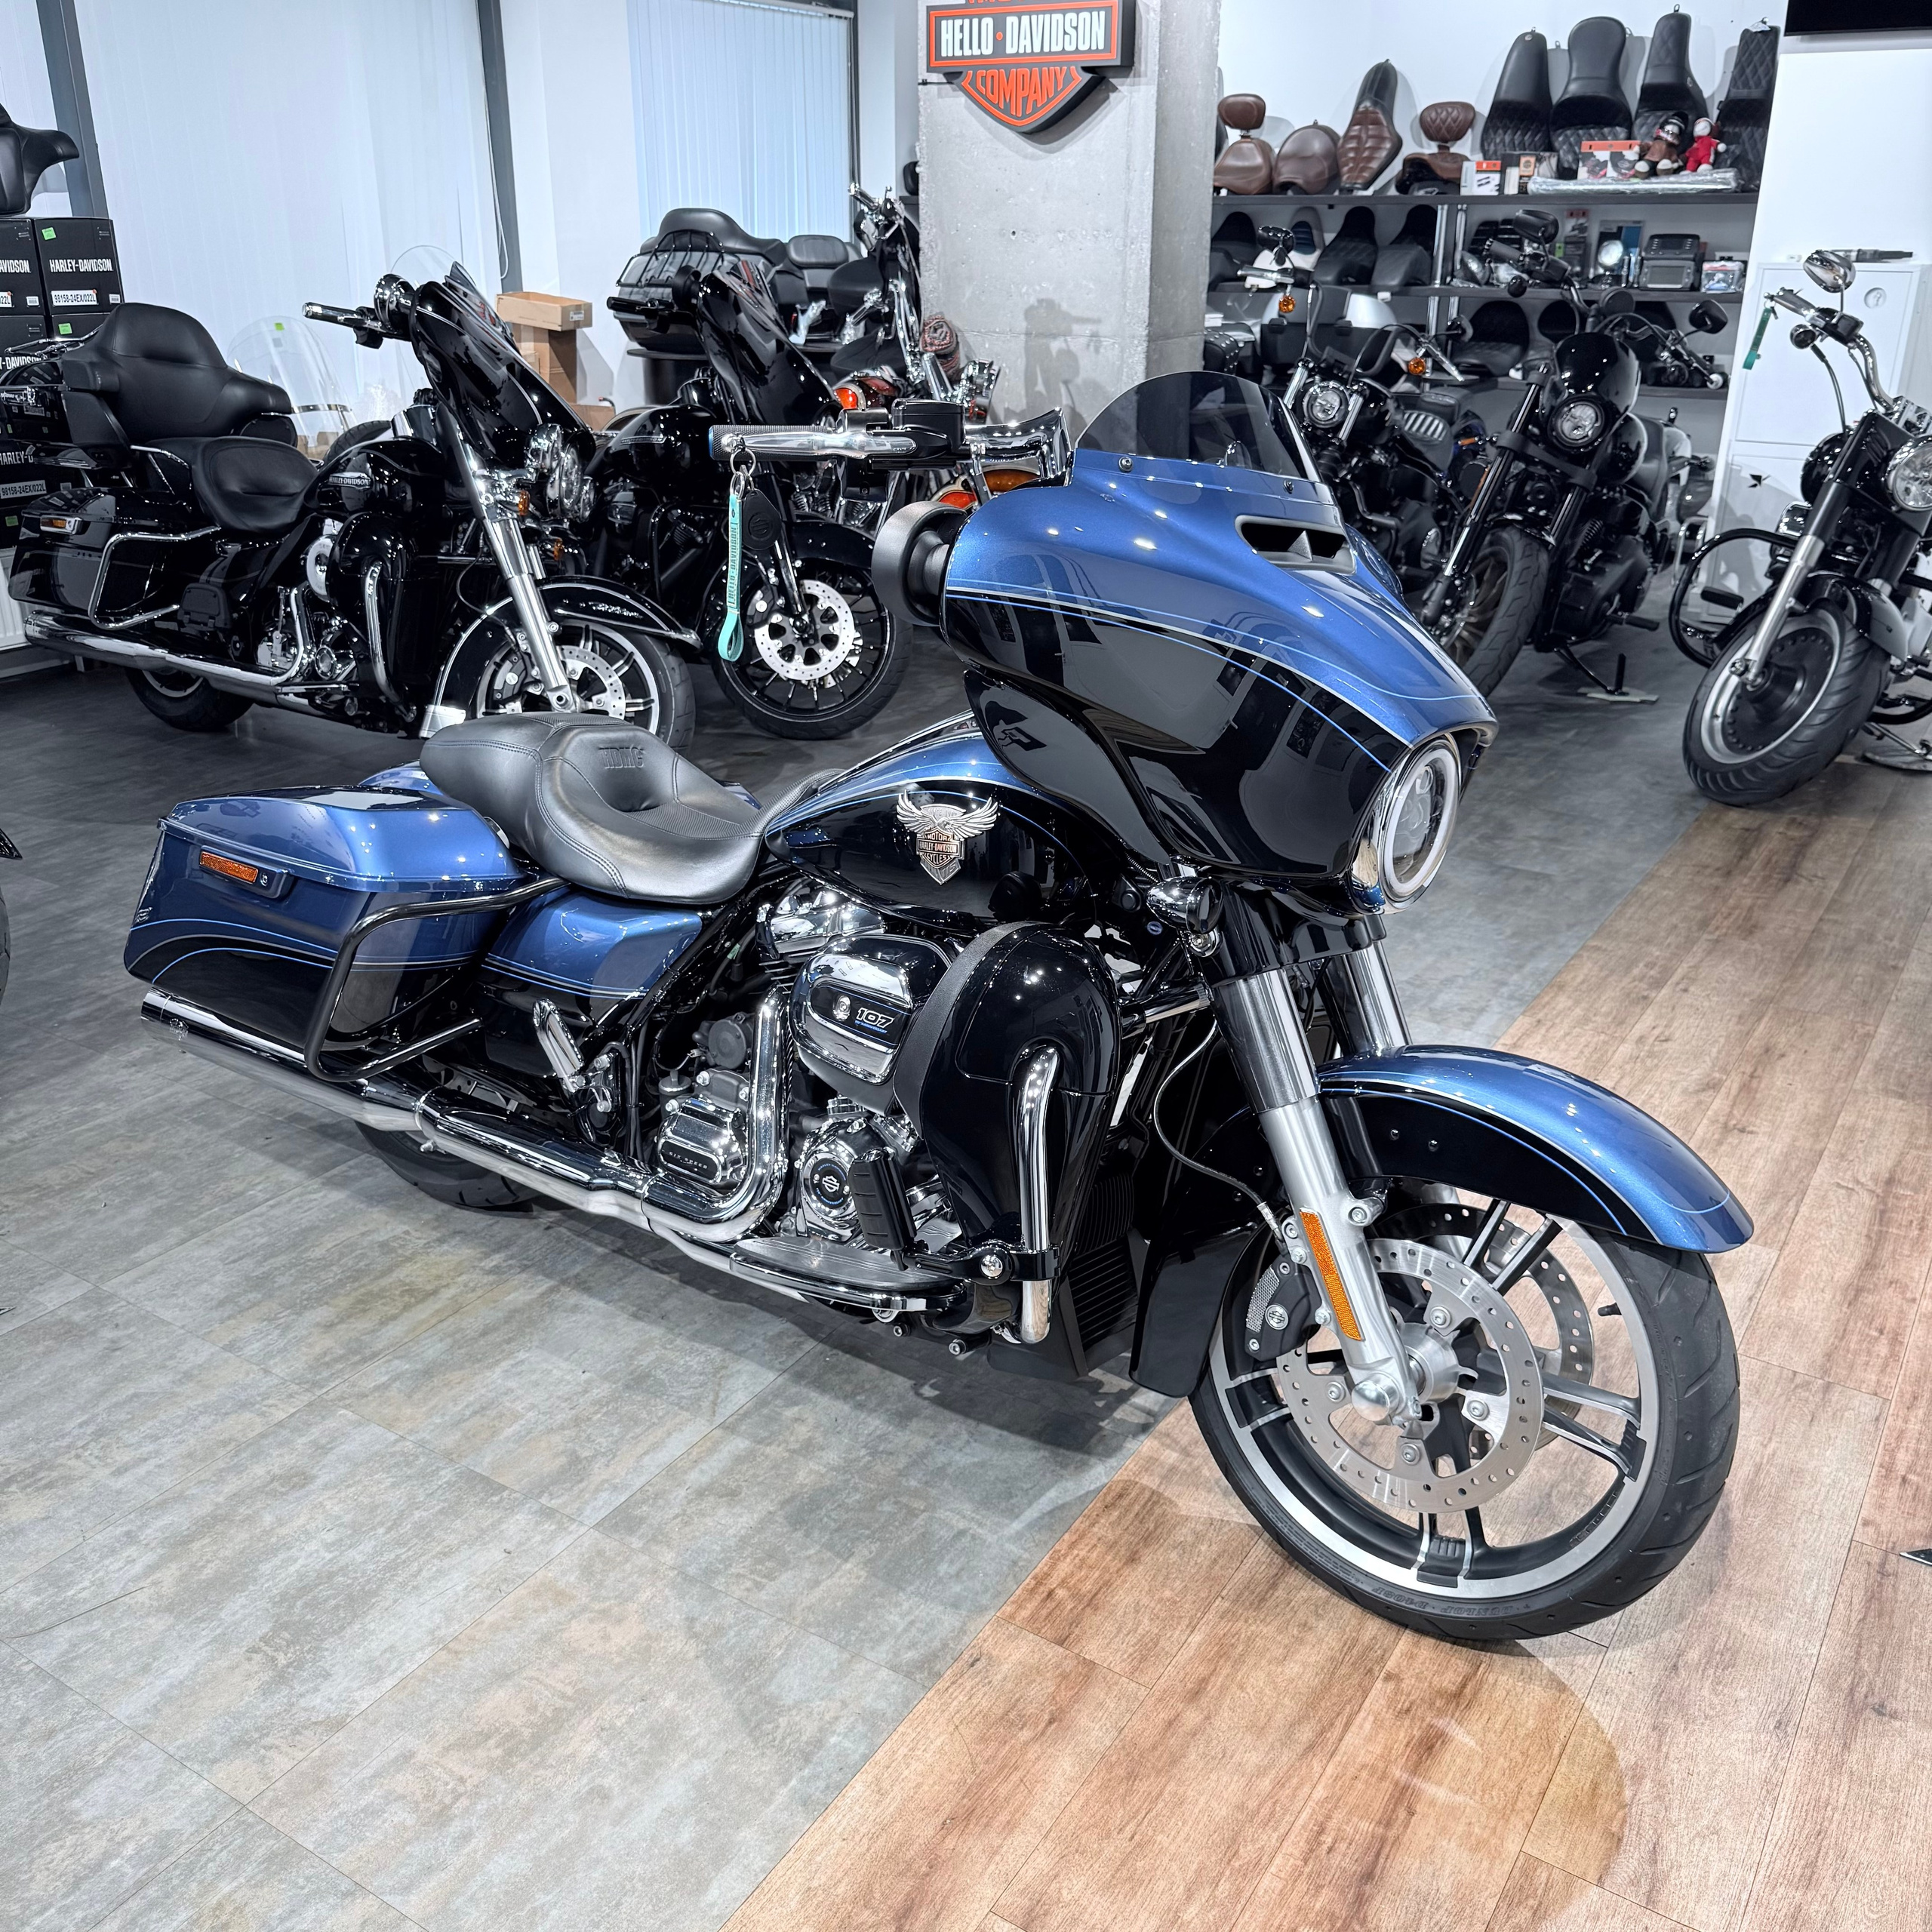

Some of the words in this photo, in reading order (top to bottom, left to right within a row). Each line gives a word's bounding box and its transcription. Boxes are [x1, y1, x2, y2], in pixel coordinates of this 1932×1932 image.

[940, 17, 993, 57] HELLO
[1005, 11, 1105, 54] DAVIDSON
[977, 66, 1066, 117] COMPANY
[49, 259, 112, 272] HARLEY-DAVIDSON
[920, 841, 957, 853] HARLEY-DAVIDSON
[927, 854, 946, 864] CYCLES
[857, 1008, 894, 1028] 107
